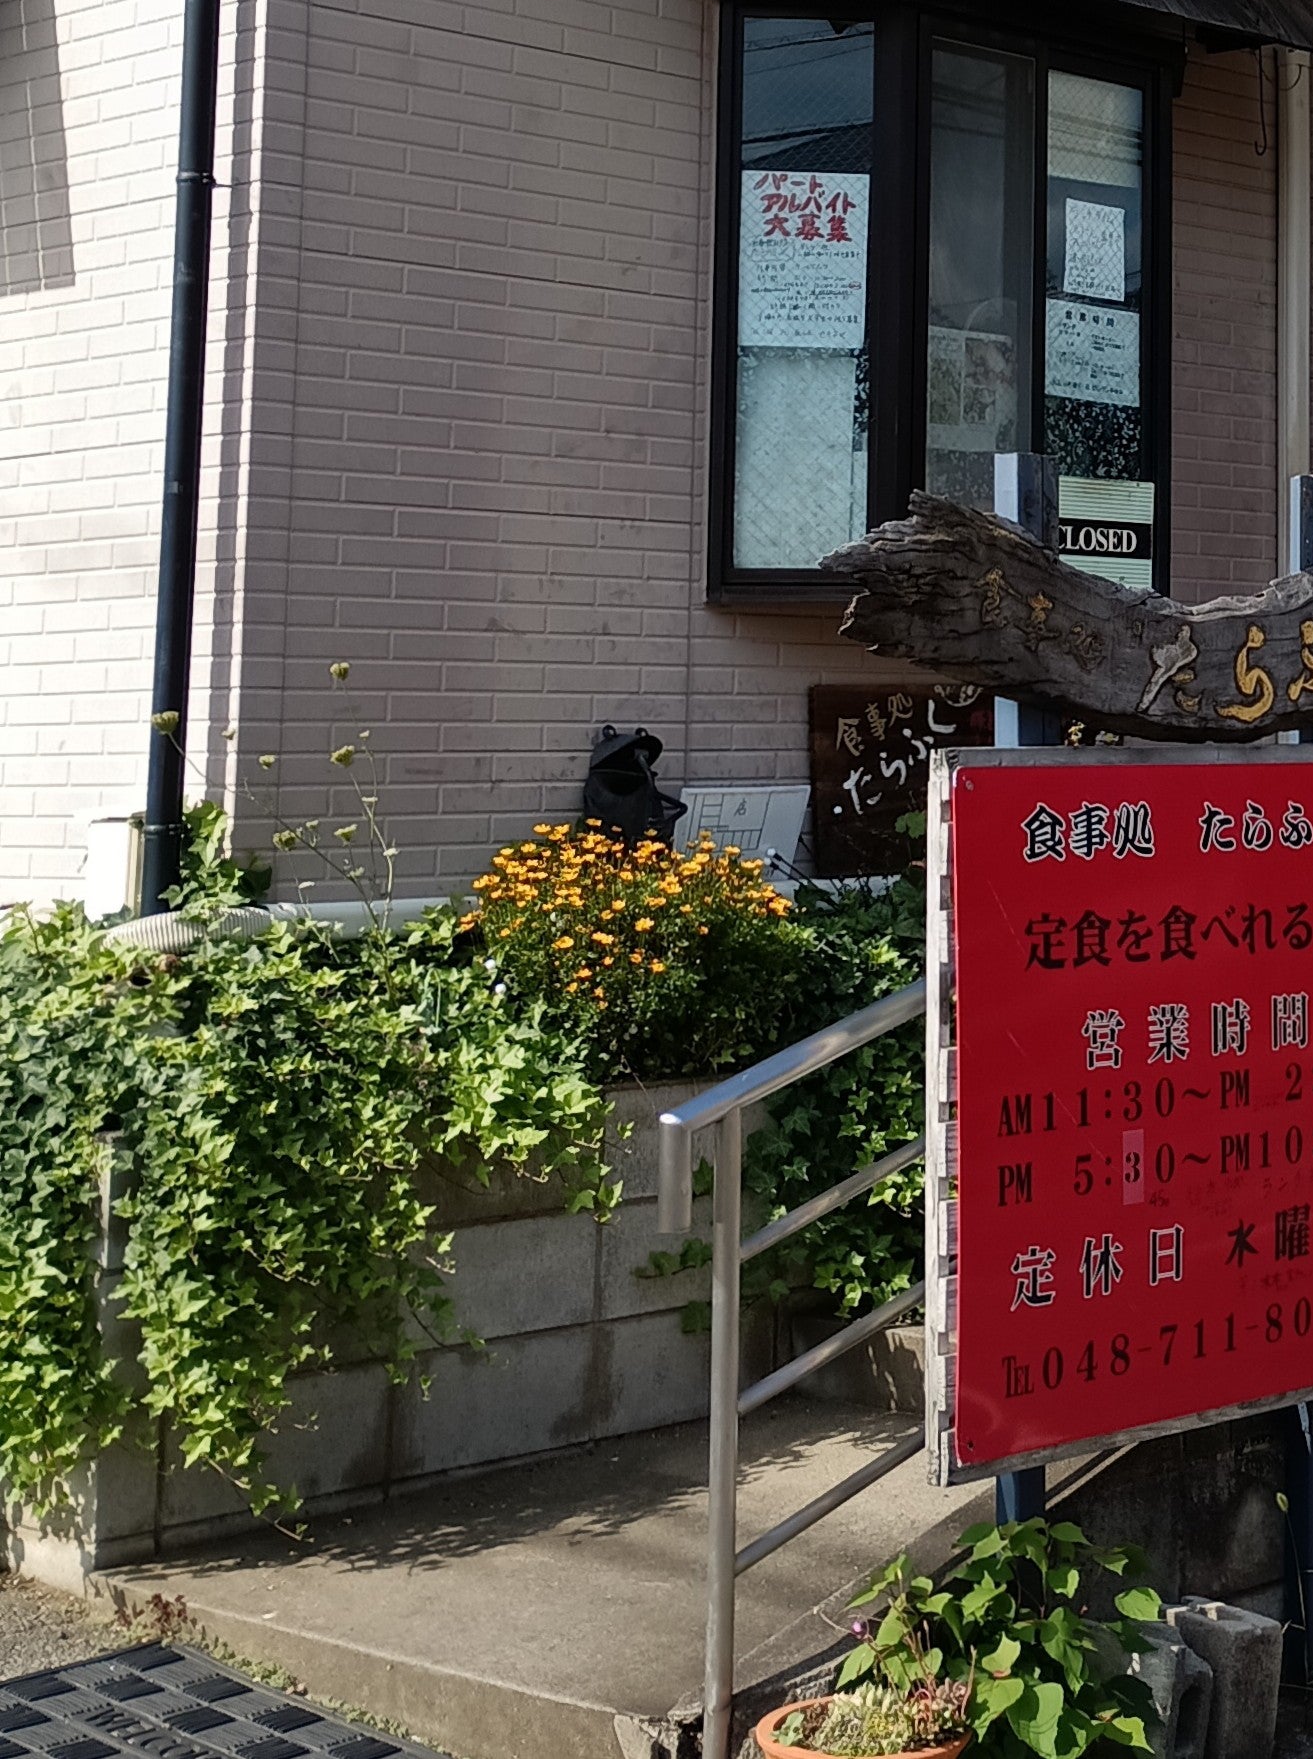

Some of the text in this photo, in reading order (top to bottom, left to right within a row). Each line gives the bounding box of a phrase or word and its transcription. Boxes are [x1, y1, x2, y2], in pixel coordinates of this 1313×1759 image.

[753, 173, 824, 195] パート
[760, 190, 857, 215] アルバイト
[763, 213, 853, 243] 大募集
[836, 692, 914, 757] 食事処
[1020, 800, 1155, 863] 食事処
[1081, 991, 1309, 1071] 営業時間
[1009, 1222, 1185, 1313] 定休日
